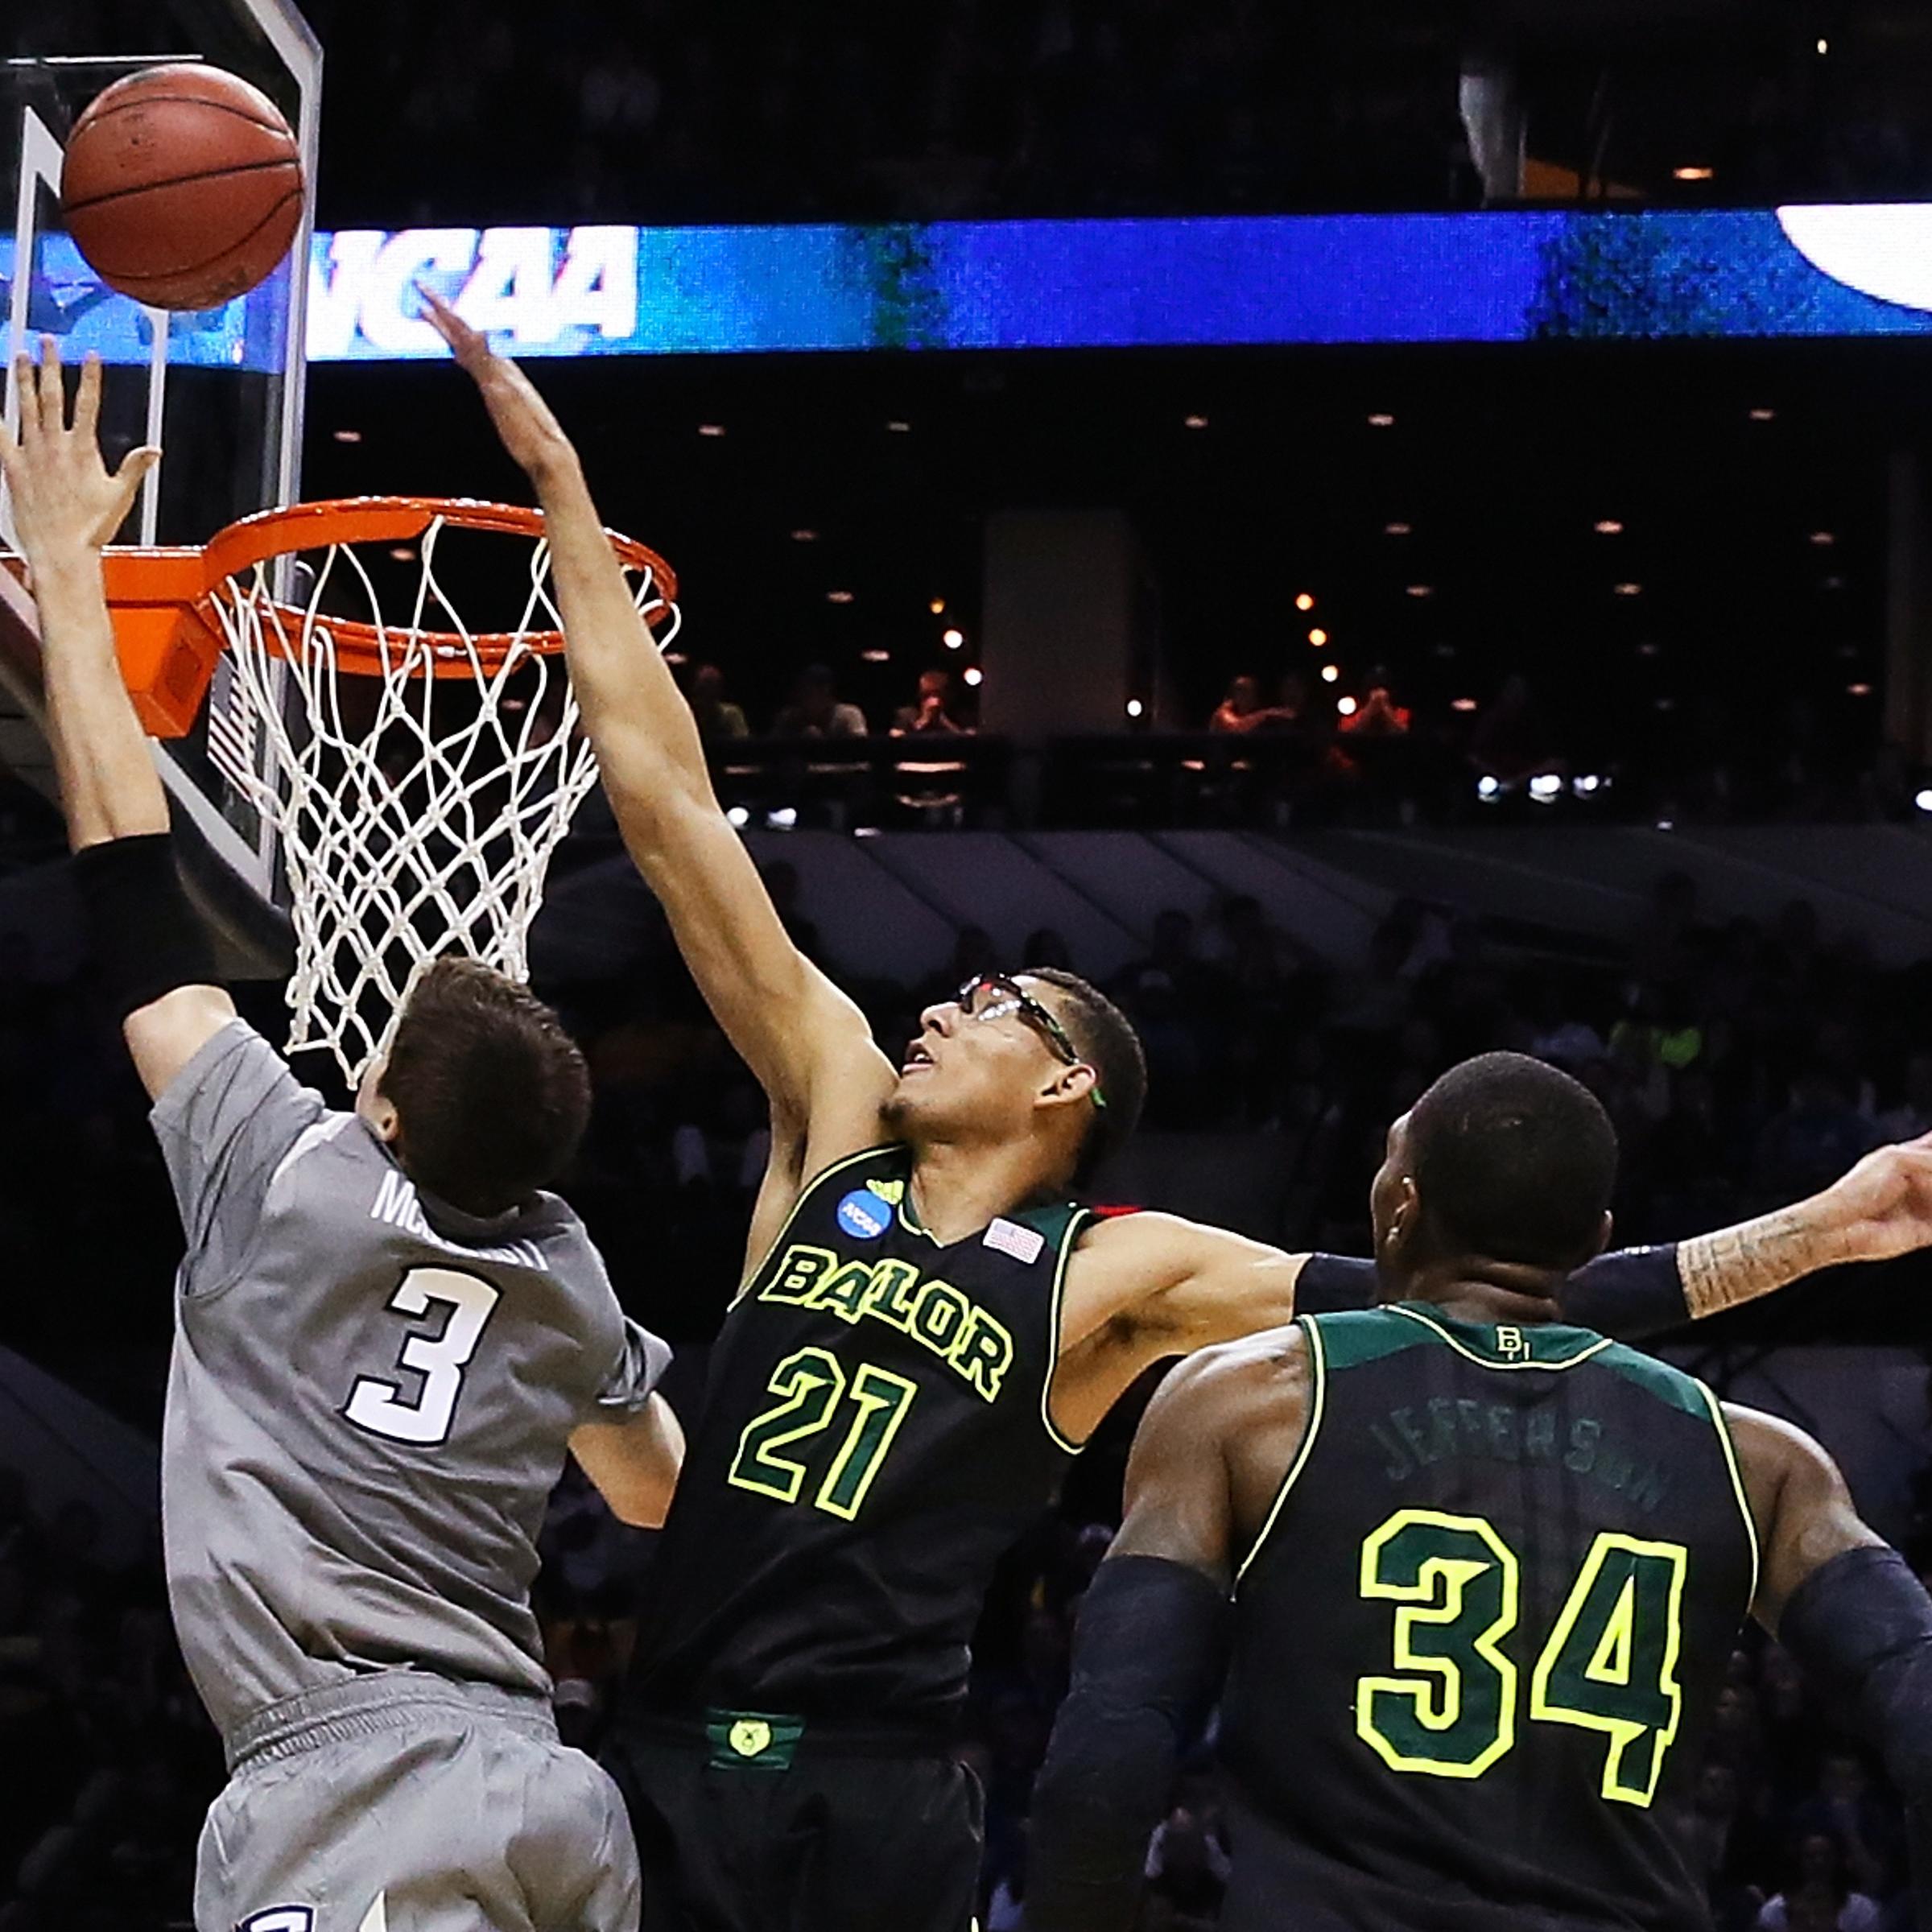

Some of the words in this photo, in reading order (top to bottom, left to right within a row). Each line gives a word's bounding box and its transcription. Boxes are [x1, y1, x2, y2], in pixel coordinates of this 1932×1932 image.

[306, 225, 639, 359] NCAA
[340, 1261, 504, 1446] 3
[757, 1244, 1015, 1403] BALOR
[728, 1346, 918, 1521] 21
[1356, 1509, 1687, 1808] 34
